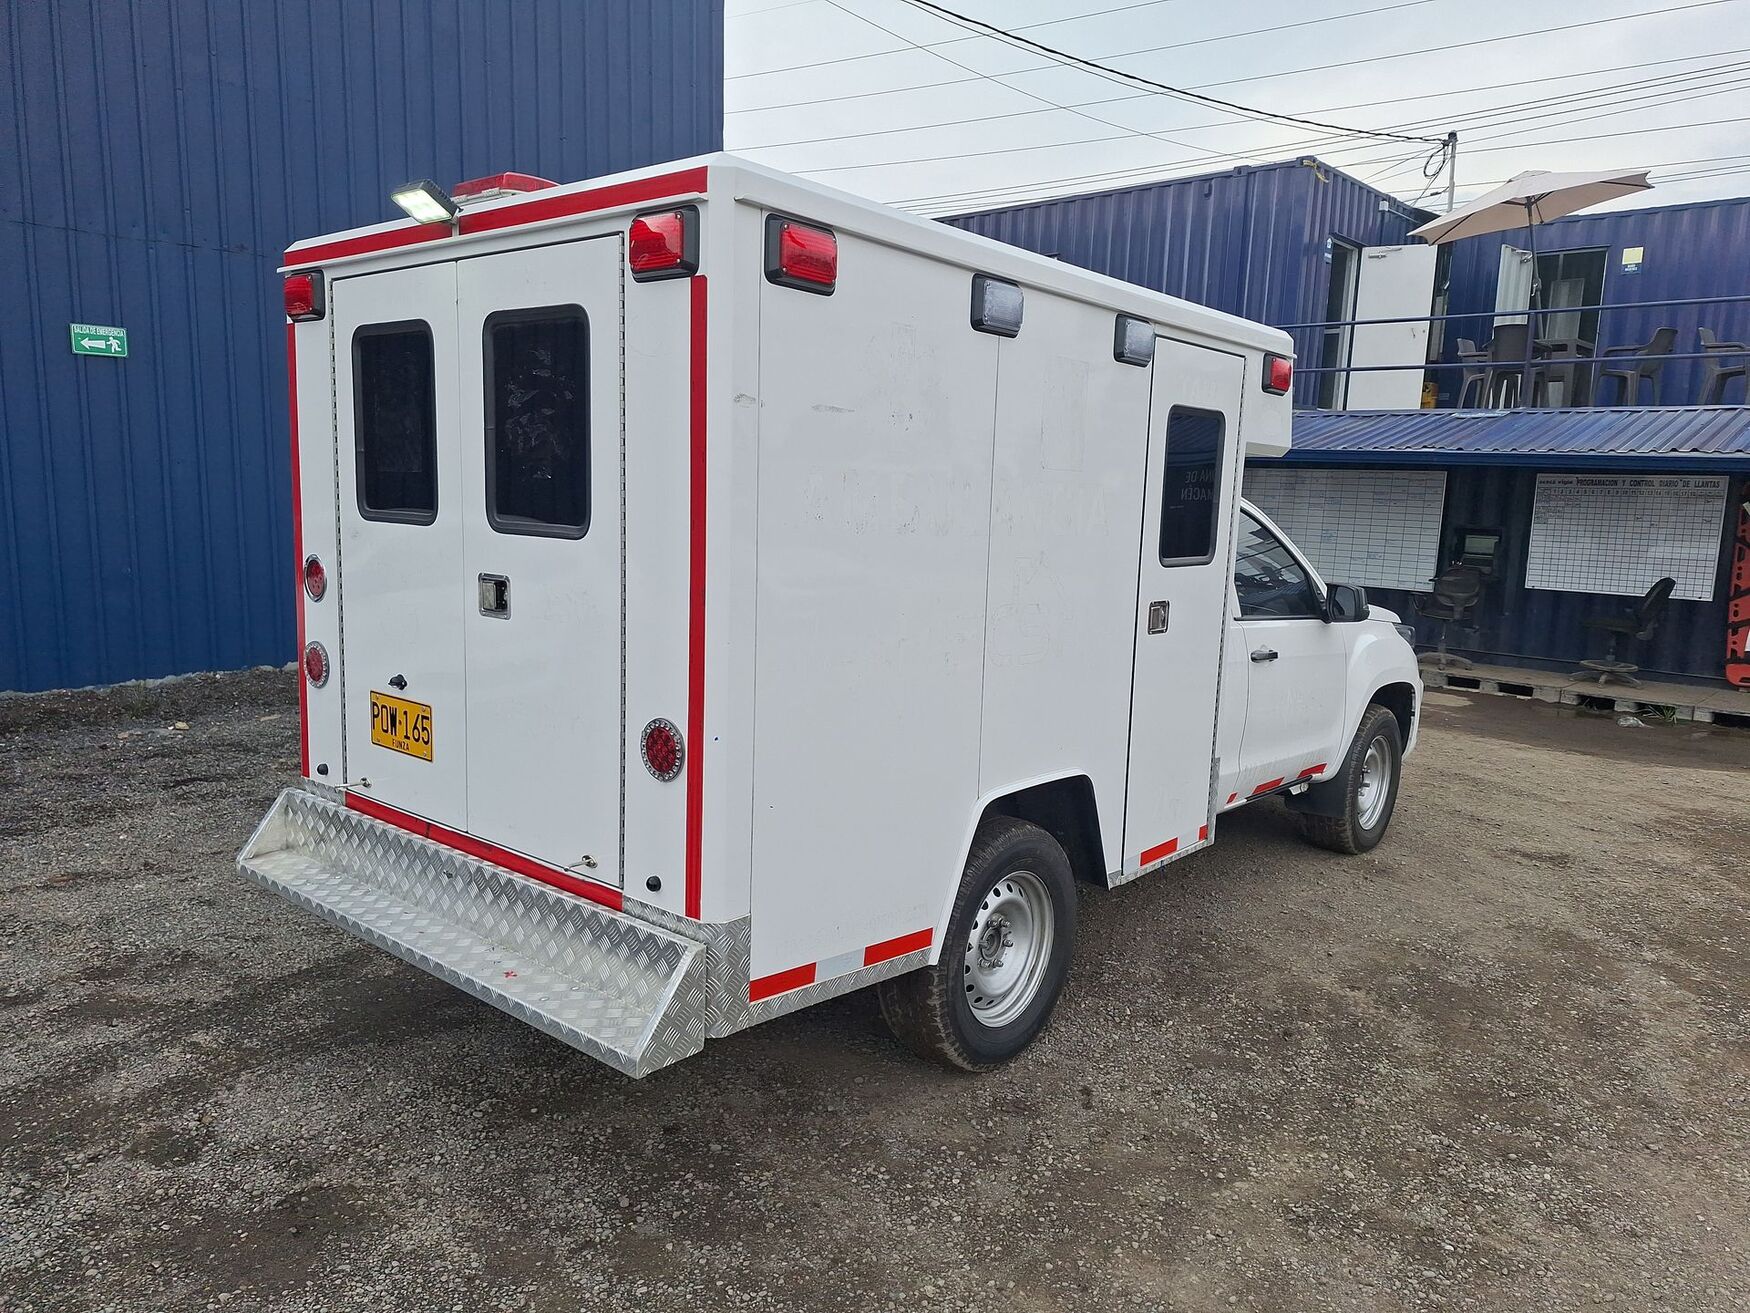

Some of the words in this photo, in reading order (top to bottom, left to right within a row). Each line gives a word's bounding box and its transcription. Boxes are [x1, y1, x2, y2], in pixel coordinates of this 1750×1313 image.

[1629, 479, 1655, 488] CONTROL
[1682, 480, 1691, 488] DE
[1694, 480, 1721, 488] LLANTAS
[392, 739, 410, 752] FUNZA
